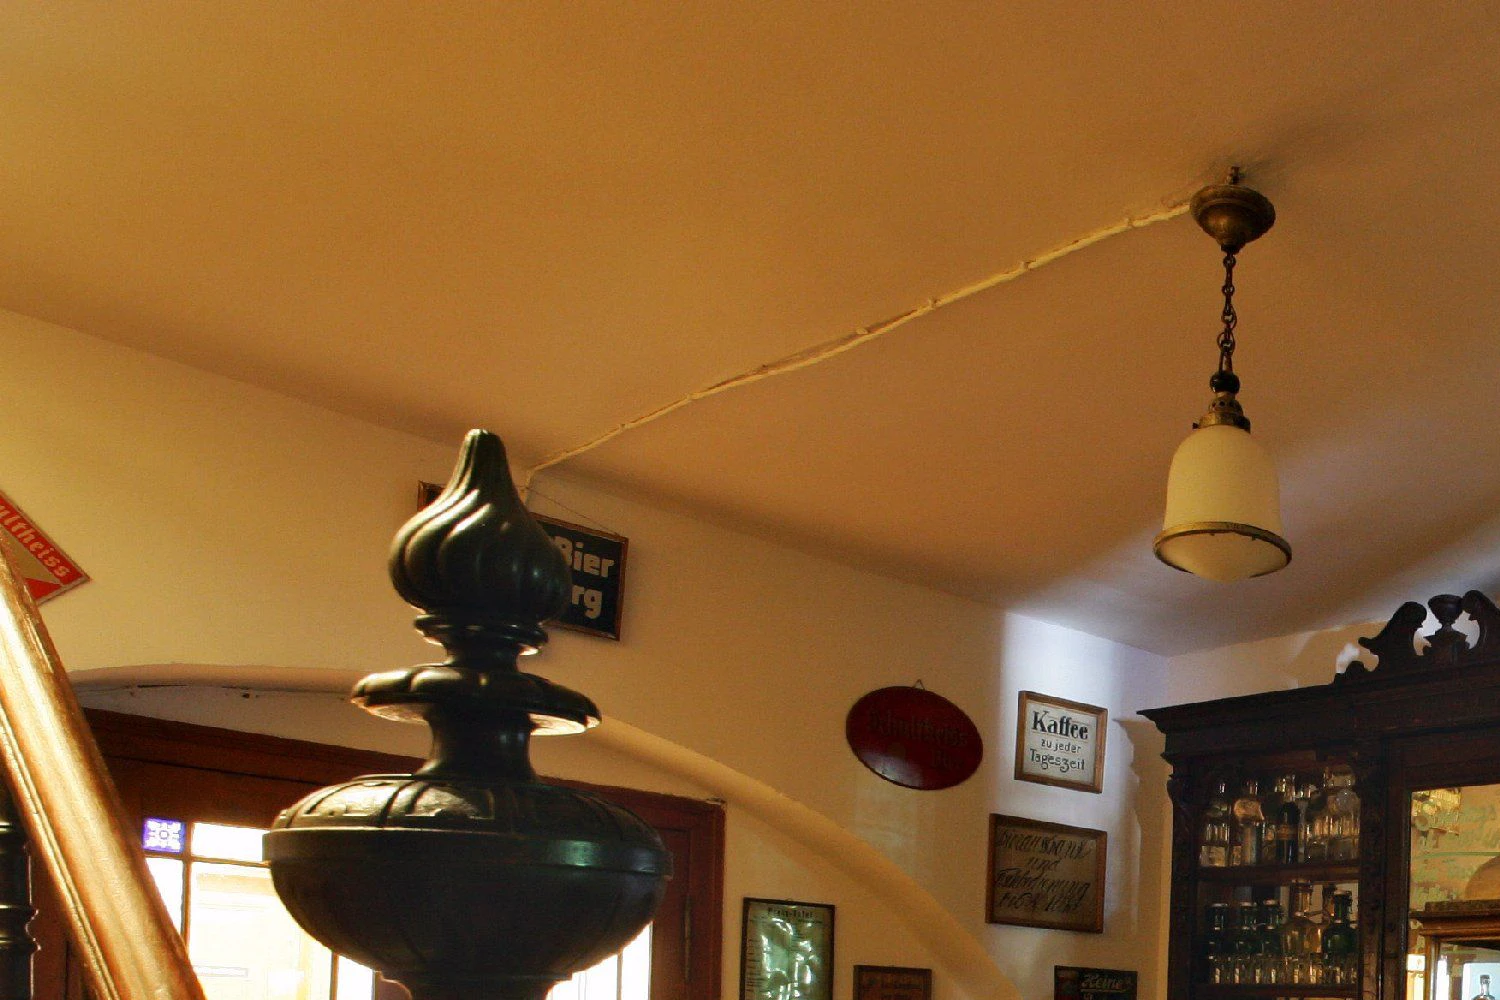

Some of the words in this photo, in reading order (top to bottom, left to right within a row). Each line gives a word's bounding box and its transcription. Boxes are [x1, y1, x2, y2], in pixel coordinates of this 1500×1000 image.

[1031, 710, 1090, 740] Kaffee
[1041, 738, 1053, 749] zu
[1053, 739, 1083, 754] jeder
[1029, 748, 1087, 773] Tageszeit
